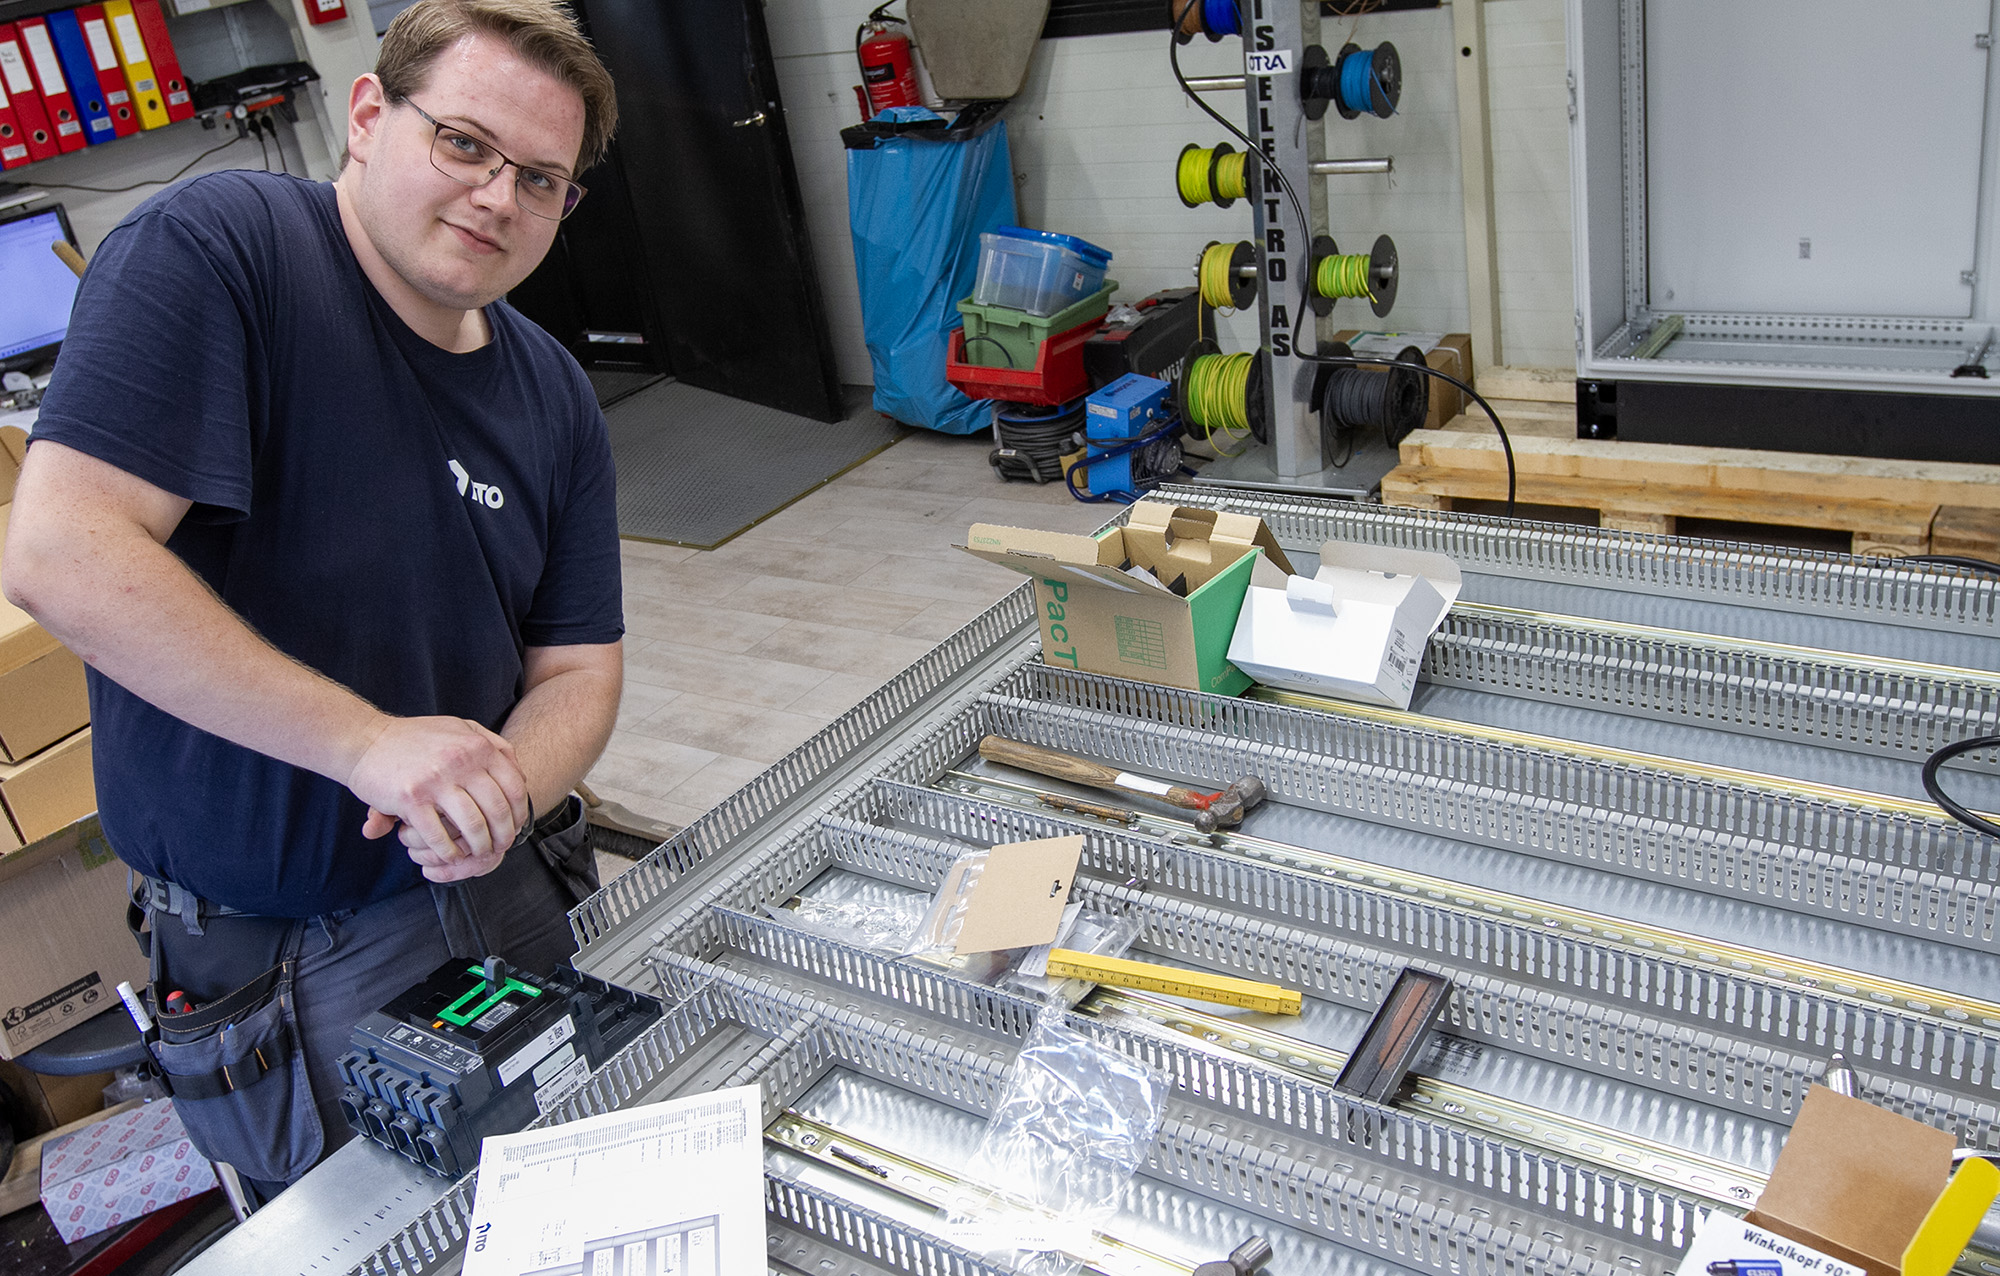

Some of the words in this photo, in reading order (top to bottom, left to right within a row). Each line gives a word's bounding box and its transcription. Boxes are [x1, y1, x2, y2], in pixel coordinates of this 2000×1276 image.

[1258, 76, 1287, 282] ELEKTRO
[1271, 305, 1290, 357] AS
[1159, 356, 1185, 384] WÜ
[1043, 578, 1079, 669] PacT
[1743, 1228, 1822, 1269] Winkelkopf
